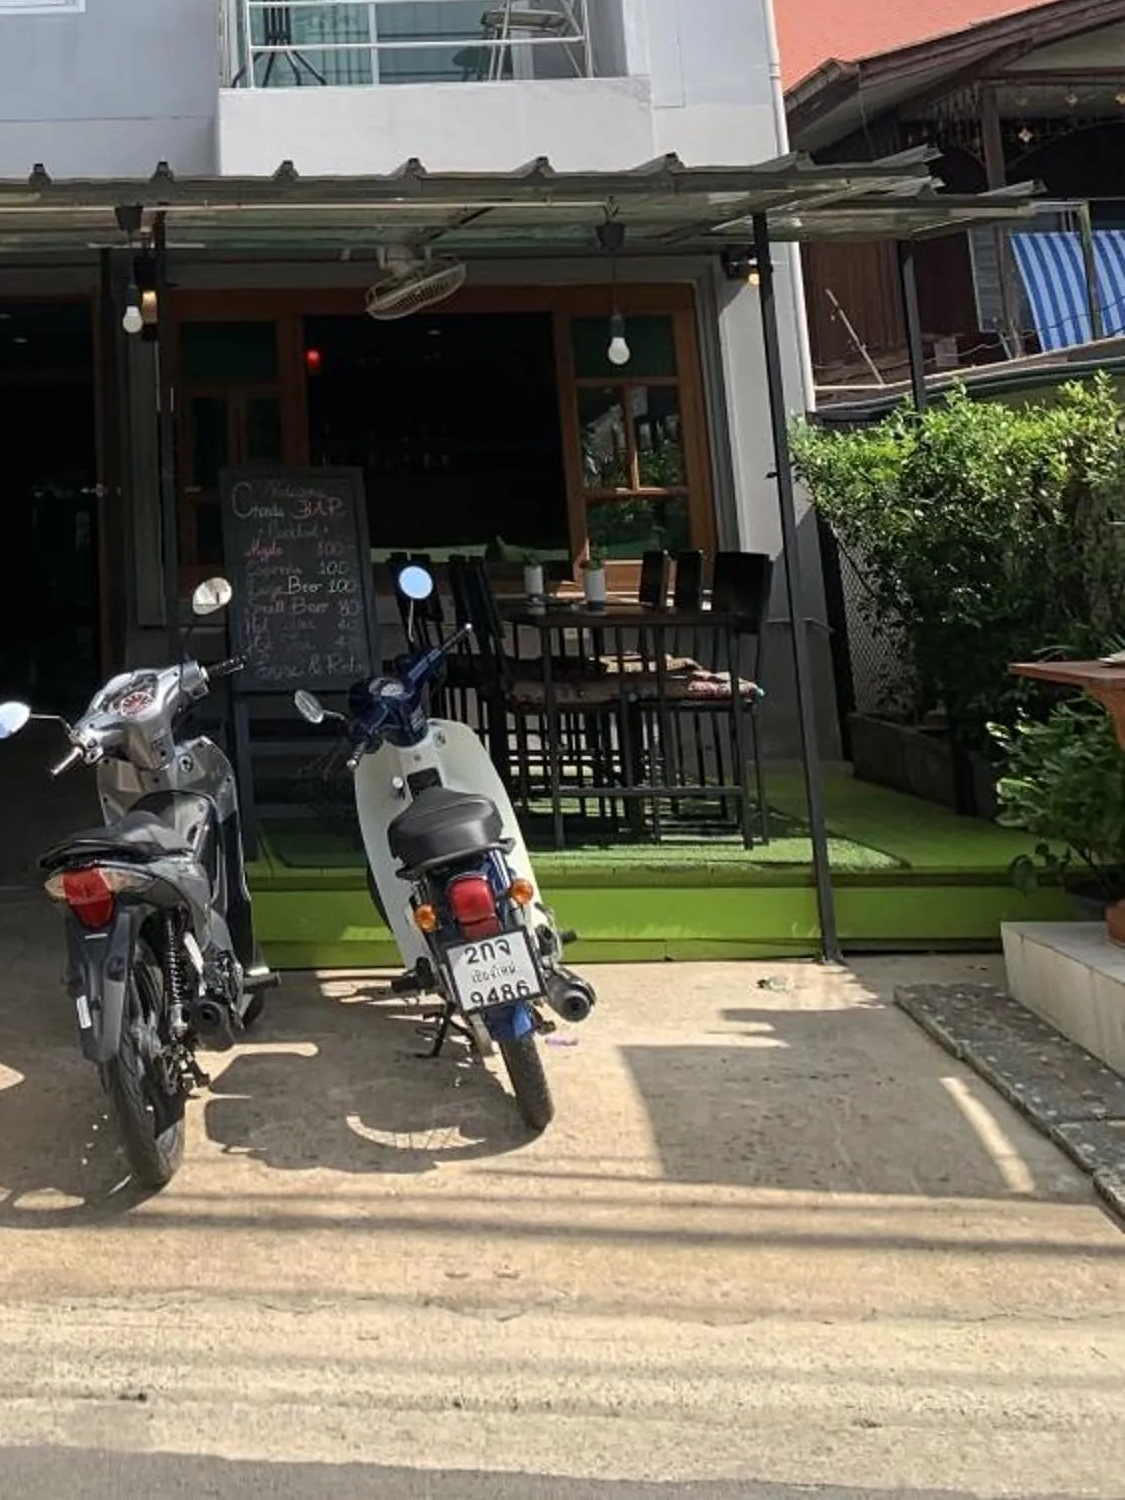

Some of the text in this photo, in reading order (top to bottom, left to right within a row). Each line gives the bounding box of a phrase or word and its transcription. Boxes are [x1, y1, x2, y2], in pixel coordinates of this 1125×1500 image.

[288, 576, 322, 594] Beer
[464, 938, 511, 965] 2กจ
[470, 979, 530, 1006] 9486
